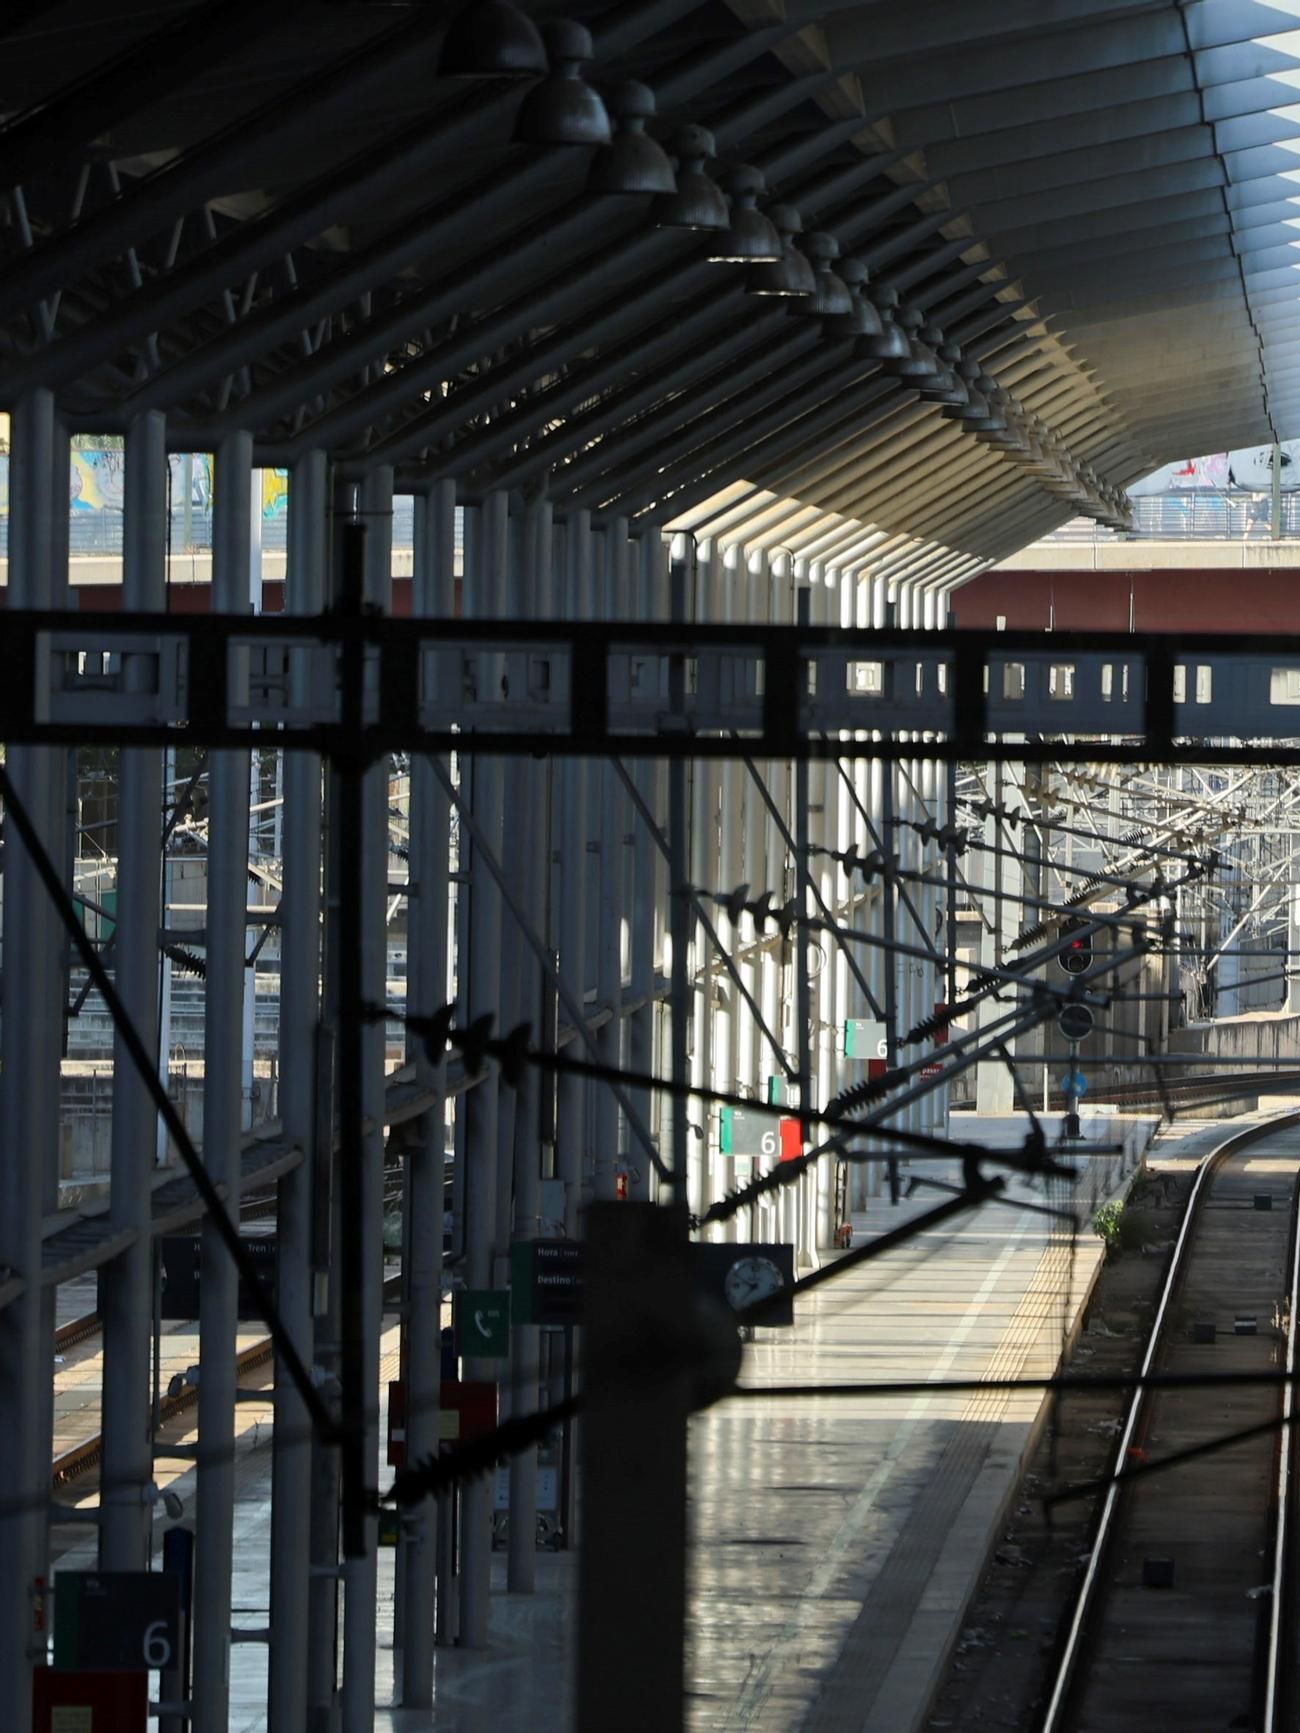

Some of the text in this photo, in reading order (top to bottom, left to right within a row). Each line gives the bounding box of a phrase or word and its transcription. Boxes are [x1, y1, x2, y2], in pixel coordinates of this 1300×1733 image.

[877, 1039, 888, 1057] 6
[761, 1131, 776, 1154] 6
[537, 1247, 560, 1257] Hora
[143, 1620, 172, 1668] 6
